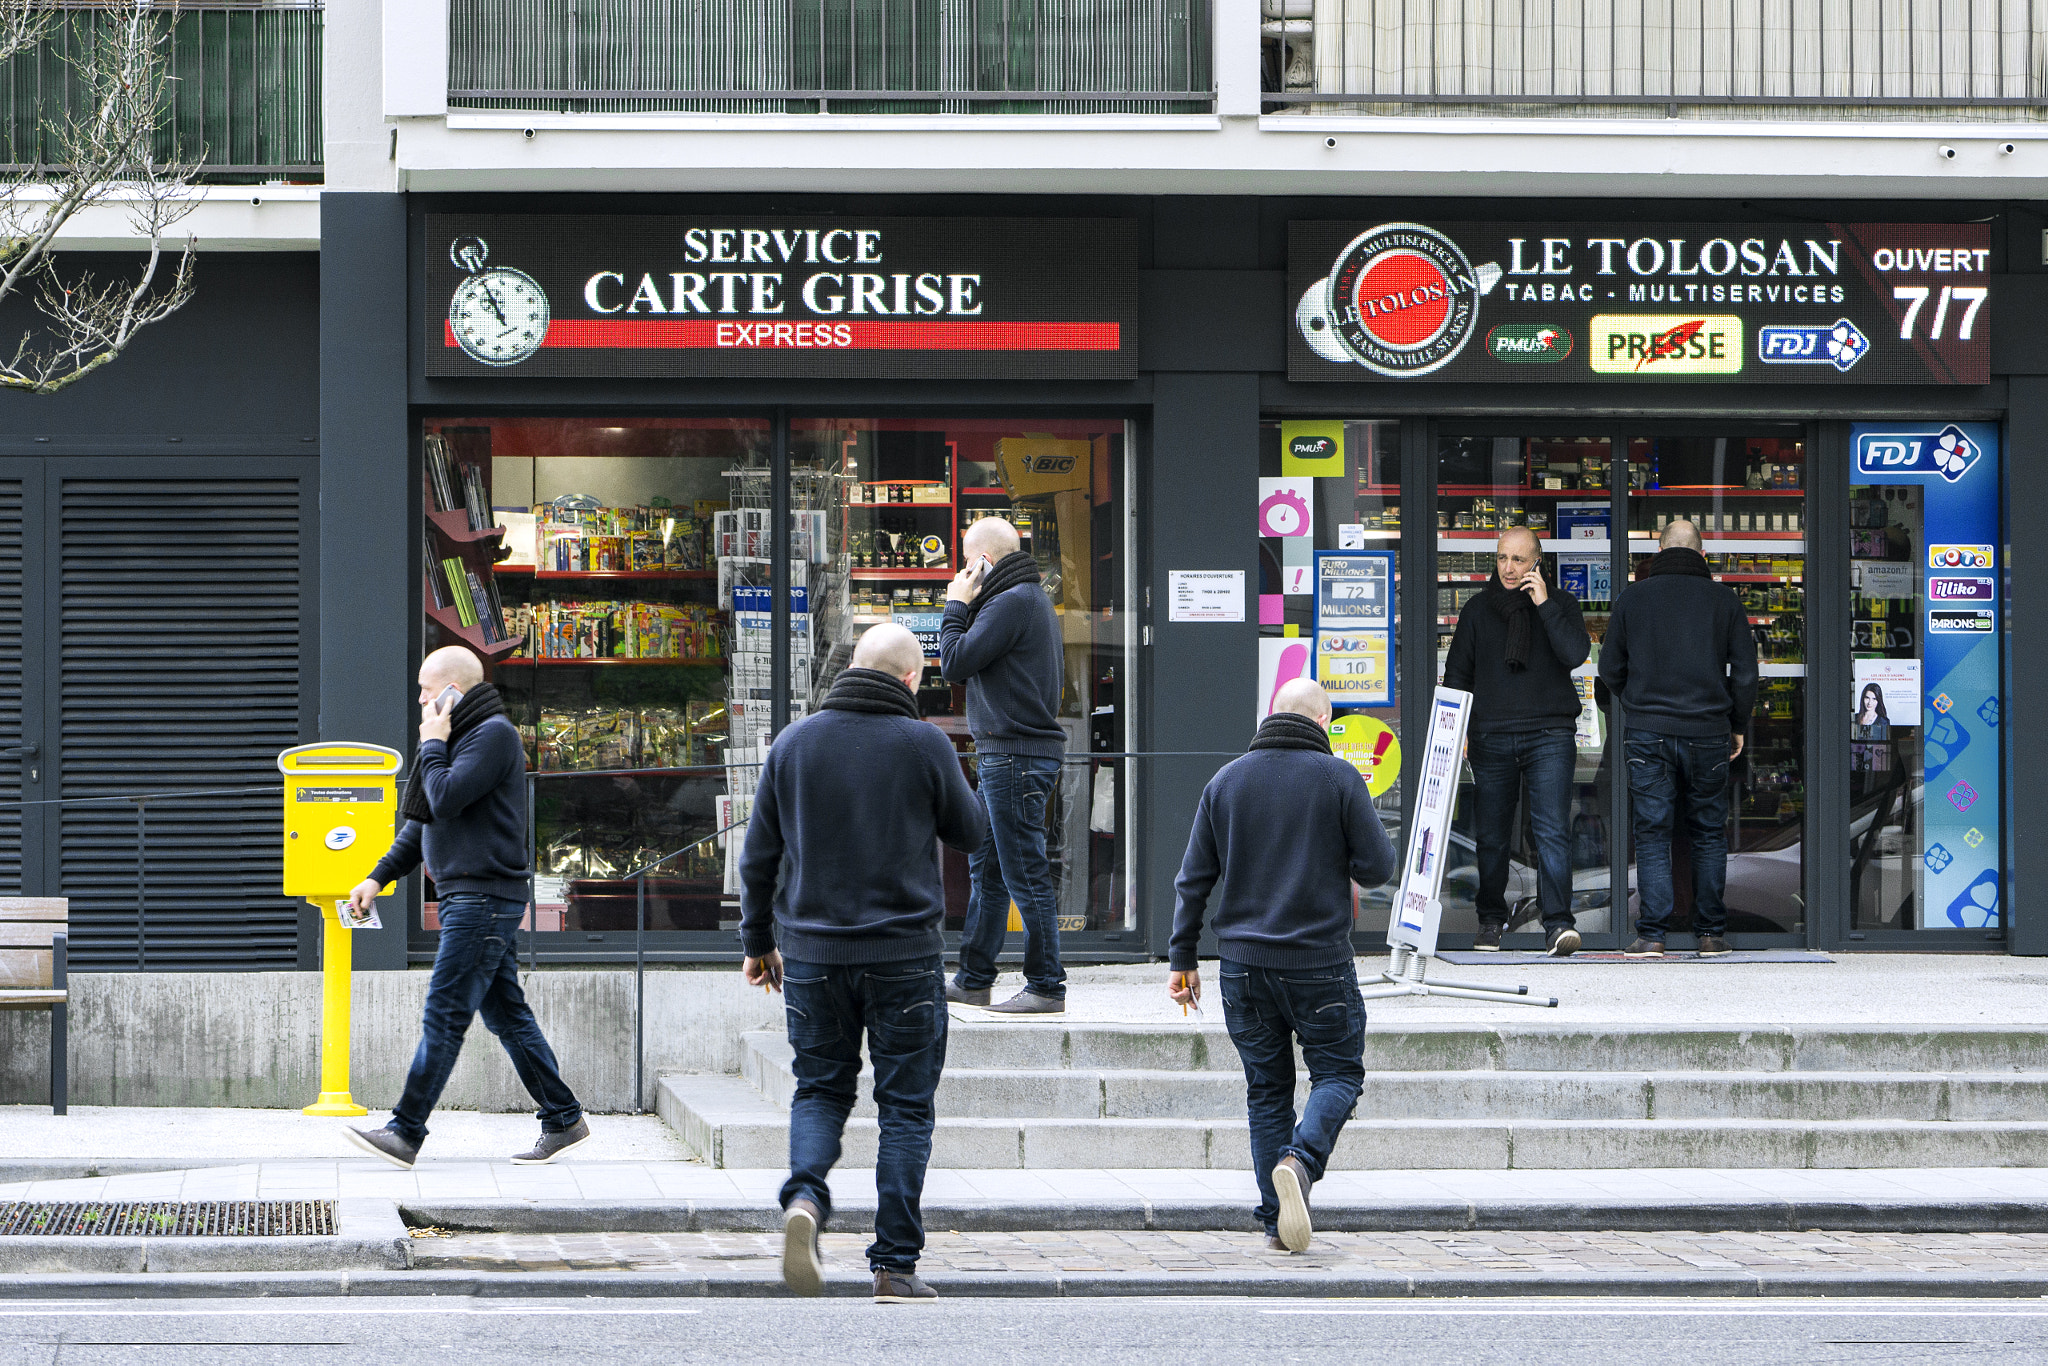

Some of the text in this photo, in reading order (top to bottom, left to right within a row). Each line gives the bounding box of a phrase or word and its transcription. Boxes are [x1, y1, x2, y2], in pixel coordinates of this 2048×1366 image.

[684, 228, 883, 263] SERVICE
[1507, 237, 1842, 276] LE TOLOSAN
[1873, 248, 1990, 272] OUVERT
[584, 271, 984, 316] CARTE GRISE
[1361, 274, 1478, 318] TOLOSAN
[1505, 283, 1594, 301] TABAC
[1629, 284, 1845, 303] MULTISERVICES
[1894, 285, 1988, 340] 7/7
[716, 323, 853, 348] EXPRESS
[1496, 336, 1538, 353] PMU
[1608, 332, 1725, 360] PRESSE
[1766, 332, 1818, 355] FDJ
[1294, 444, 1317, 453] PMU
[1865, 441, 1922, 466] FDJ
[1036, 459, 1073, 471] BIC
[1583, 529, 1595, 538] 19
[1934, 547, 1986, 567] LOTO
[1321, 560, 1348, 569] EURO
[1868, 566, 1908, 575] amazon.fr
[1324, 568, 1365, 576] MILLIONS
[1563, 579, 1579, 590] 72
[1593, 579, 1608, 590] 10
[1935, 580, 1977, 598] illiko
[735, 588, 805, 598] LE FIRO
[1345, 586, 1364, 599] 72
[1322, 604, 1372, 616] MILLIONS
[896, 615, 941, 629] ReBadg
[1931, 618, 1975, 629] PARIONS
[1346, 661, 1366, 675] 10
[1320, 679, 1371, 690] MILLIONS
[1345, 750, 1374, 759] million
